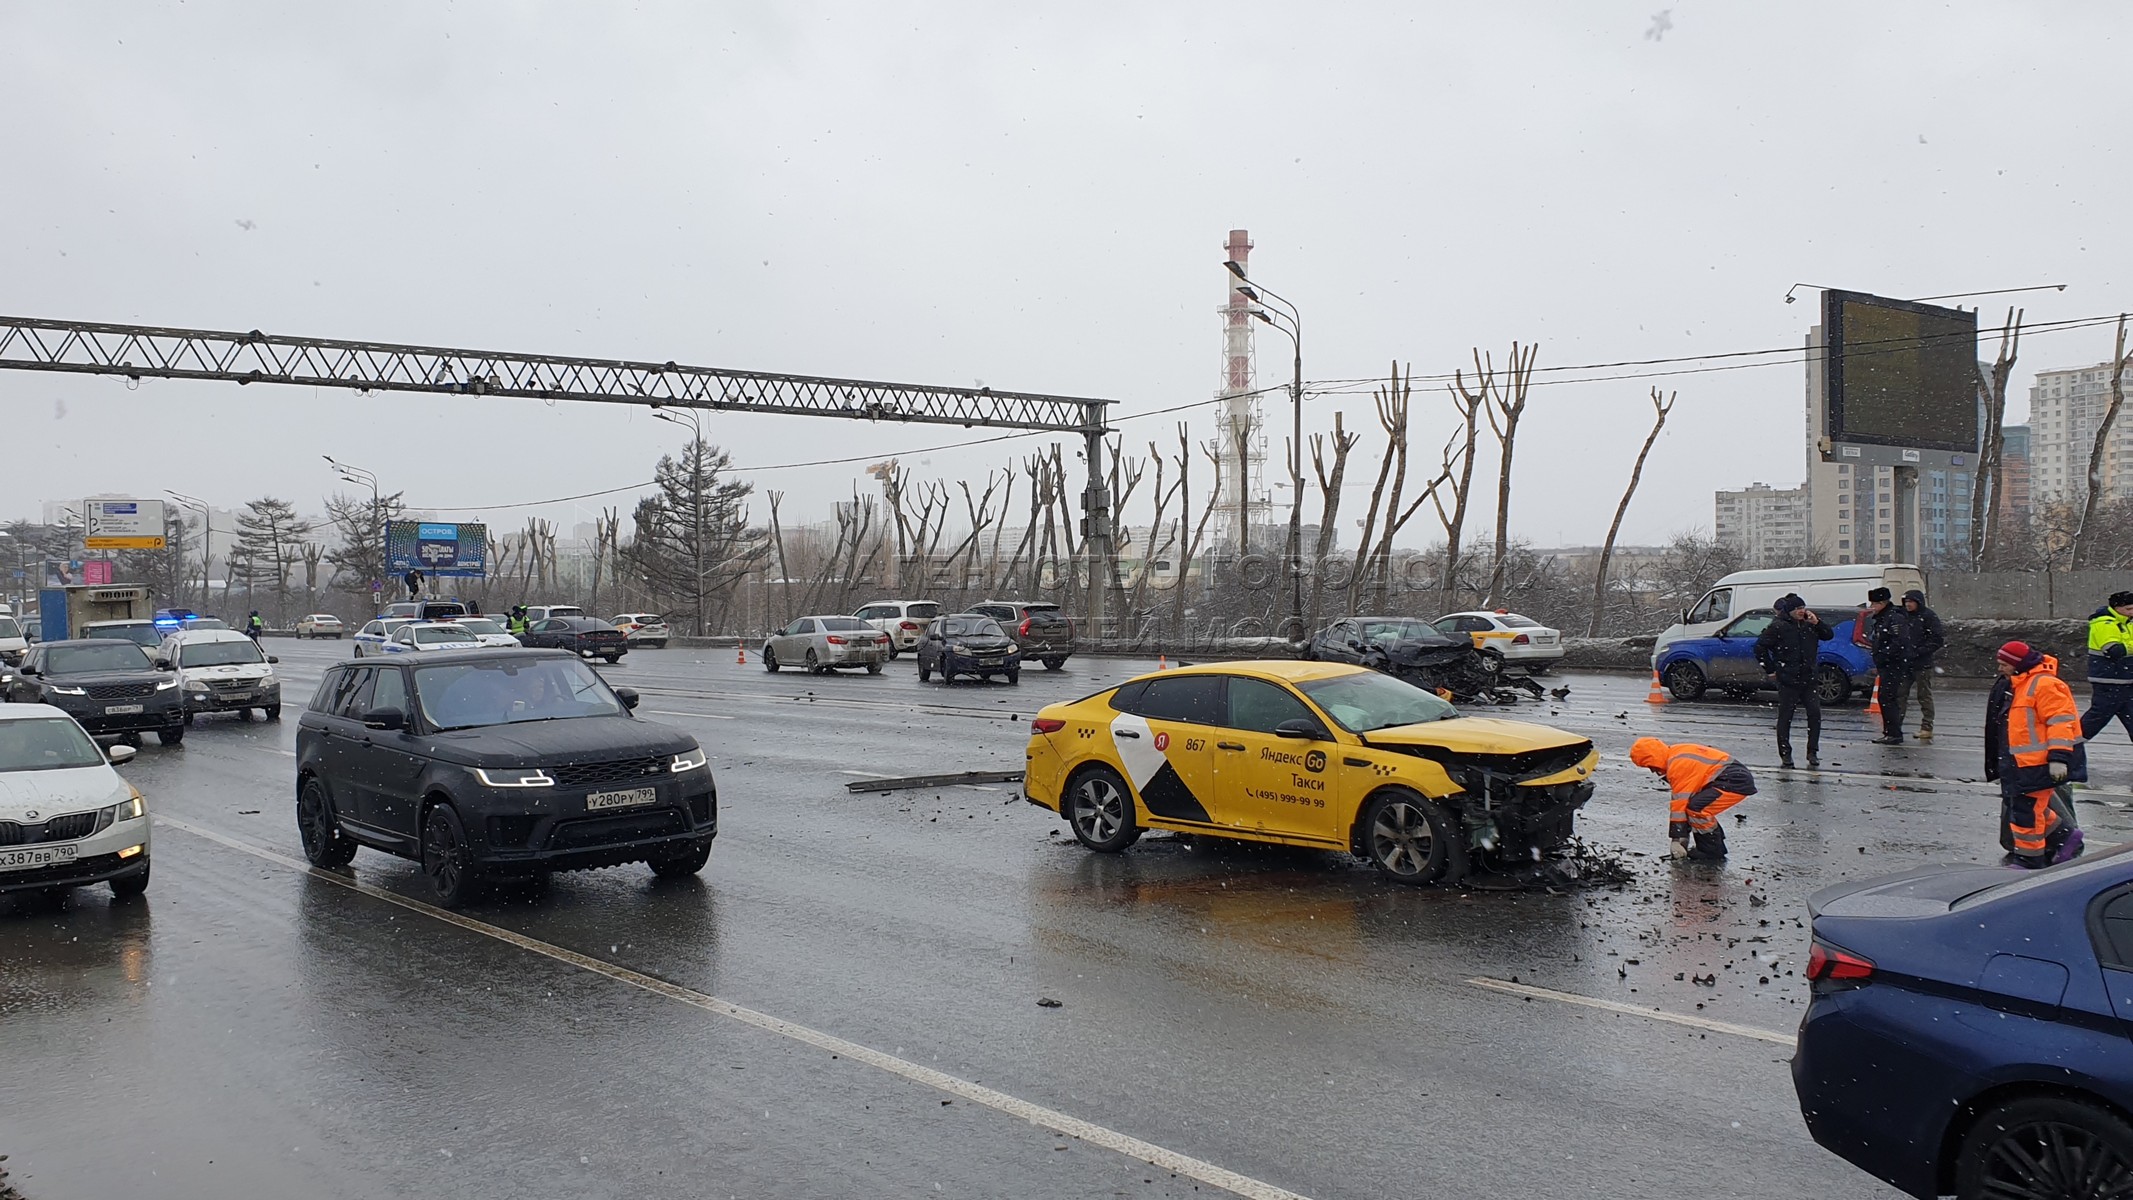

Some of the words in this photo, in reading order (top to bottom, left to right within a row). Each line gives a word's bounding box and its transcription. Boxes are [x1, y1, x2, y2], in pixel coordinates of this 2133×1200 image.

[1185, 738, 1206, 752] 867
[1260, 747, 1303, 766] Яндекс
[1307, 753, 1324, 770] Go
[1291, 772, 1325, 791] Такси
[1255, 788, 1278, 802] (495)
